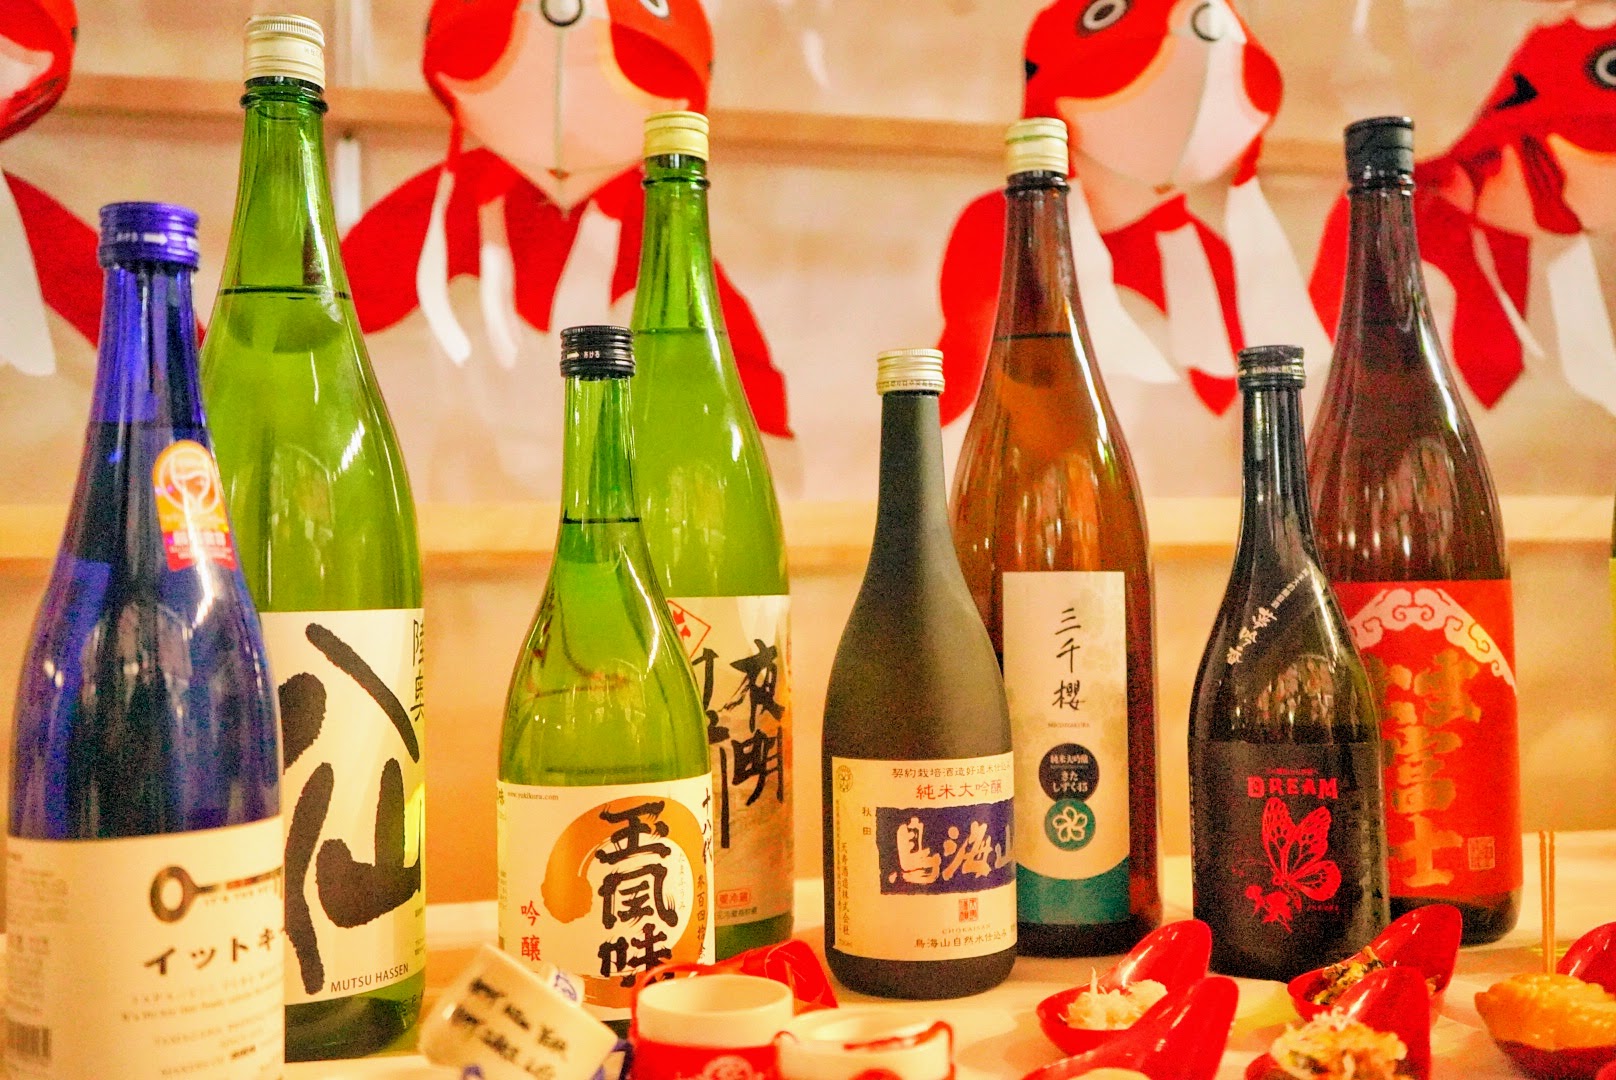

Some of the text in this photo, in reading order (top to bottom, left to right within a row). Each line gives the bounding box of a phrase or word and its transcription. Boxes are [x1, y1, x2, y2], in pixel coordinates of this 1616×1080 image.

[915, 779, 1003, 801] 純米大吟醸
[1247, 775, 1339, 800] DREAM
[861, 806, 872, 836] 秋田
[520, 899, 541, 962] 吟醸
[330, 962, 409, 993] MUTSU HASSEN
